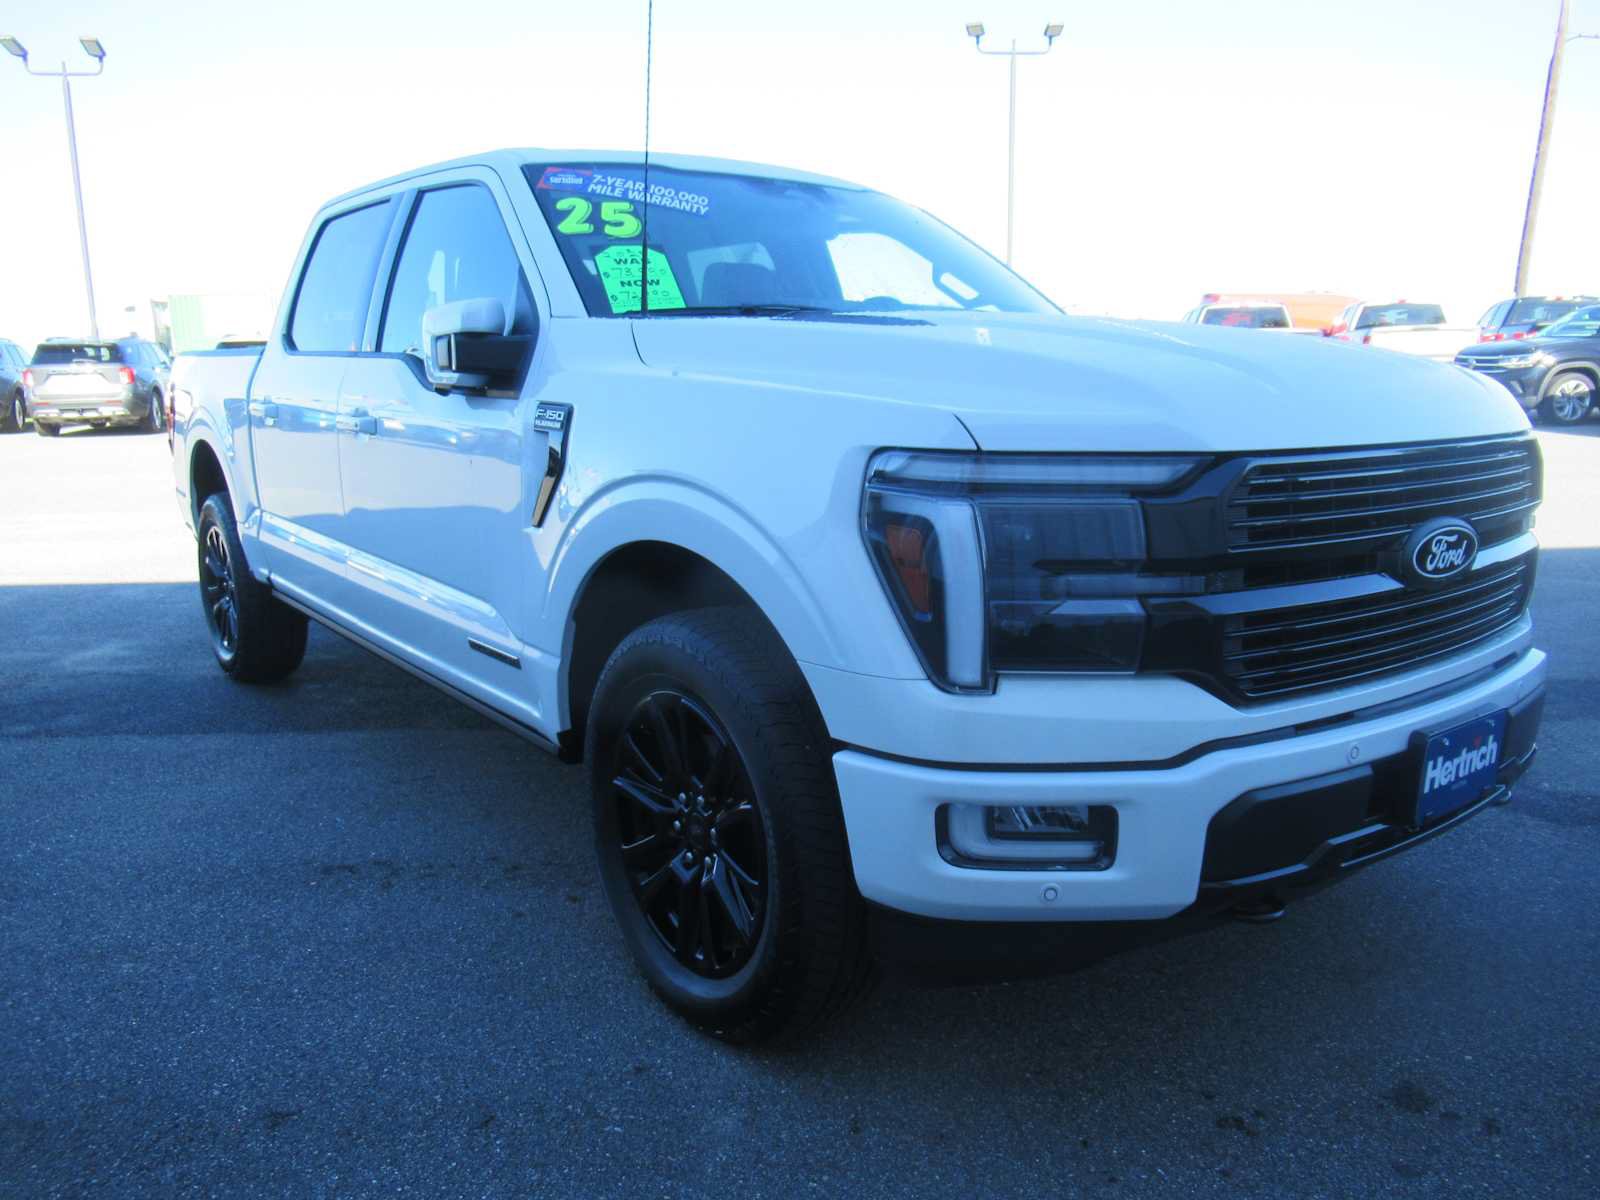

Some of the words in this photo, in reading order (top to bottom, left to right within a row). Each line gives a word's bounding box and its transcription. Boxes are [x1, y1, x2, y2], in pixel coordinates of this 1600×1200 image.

[588, 183, 625, 198] MILE
[628, 190, 710, 216] WARRANTY
[592, 174, 645, 190] 7-YEAR
[556, 197, 642, 238] 25
[1426, 533, 1468, 571] Ford
[1423, 734, 1498, 794] Hertrich
